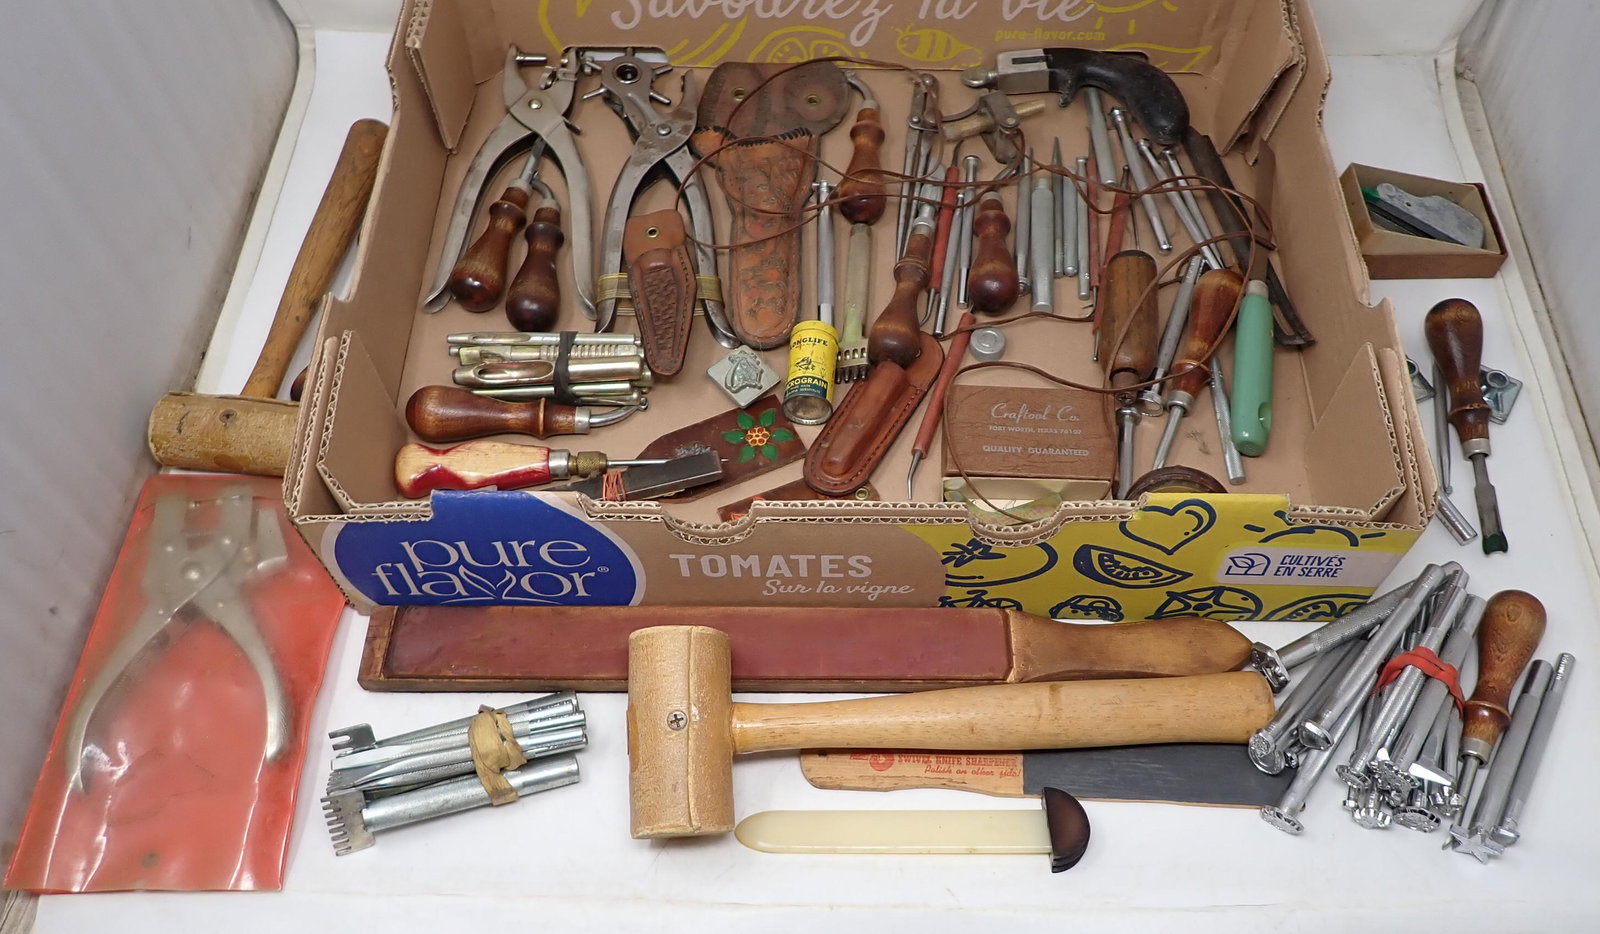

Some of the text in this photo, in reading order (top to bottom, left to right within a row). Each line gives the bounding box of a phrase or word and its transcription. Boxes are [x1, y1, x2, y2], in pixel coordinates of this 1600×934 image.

[995, 28, 1105, 42] pure-flavor.com
[790, 337, 828, 349] ONGLIFE
[991, 402, 1080, 424] Craftool Co.
[989, 424, 1006, 432] FORT
[982, 445, 1090, 456] QUALITY GUARANTEED
[400, 539, 591, 573] pure
[1279, 554, 1346, 567] CULTIVÉS
[669, 553, 873, 578] TOMATES
[1273, 566, 1344, 578] EN SERRE
[762, 579, 915, 601] Sur la vigne
[898, 754, 932, 764] SWIVEL
[935, 755, 962, 765] KNIFE
[924, 765, 952, 774] Polish
[971, 768, 994, 776] other
[999, 769, 1021, 779] side!
